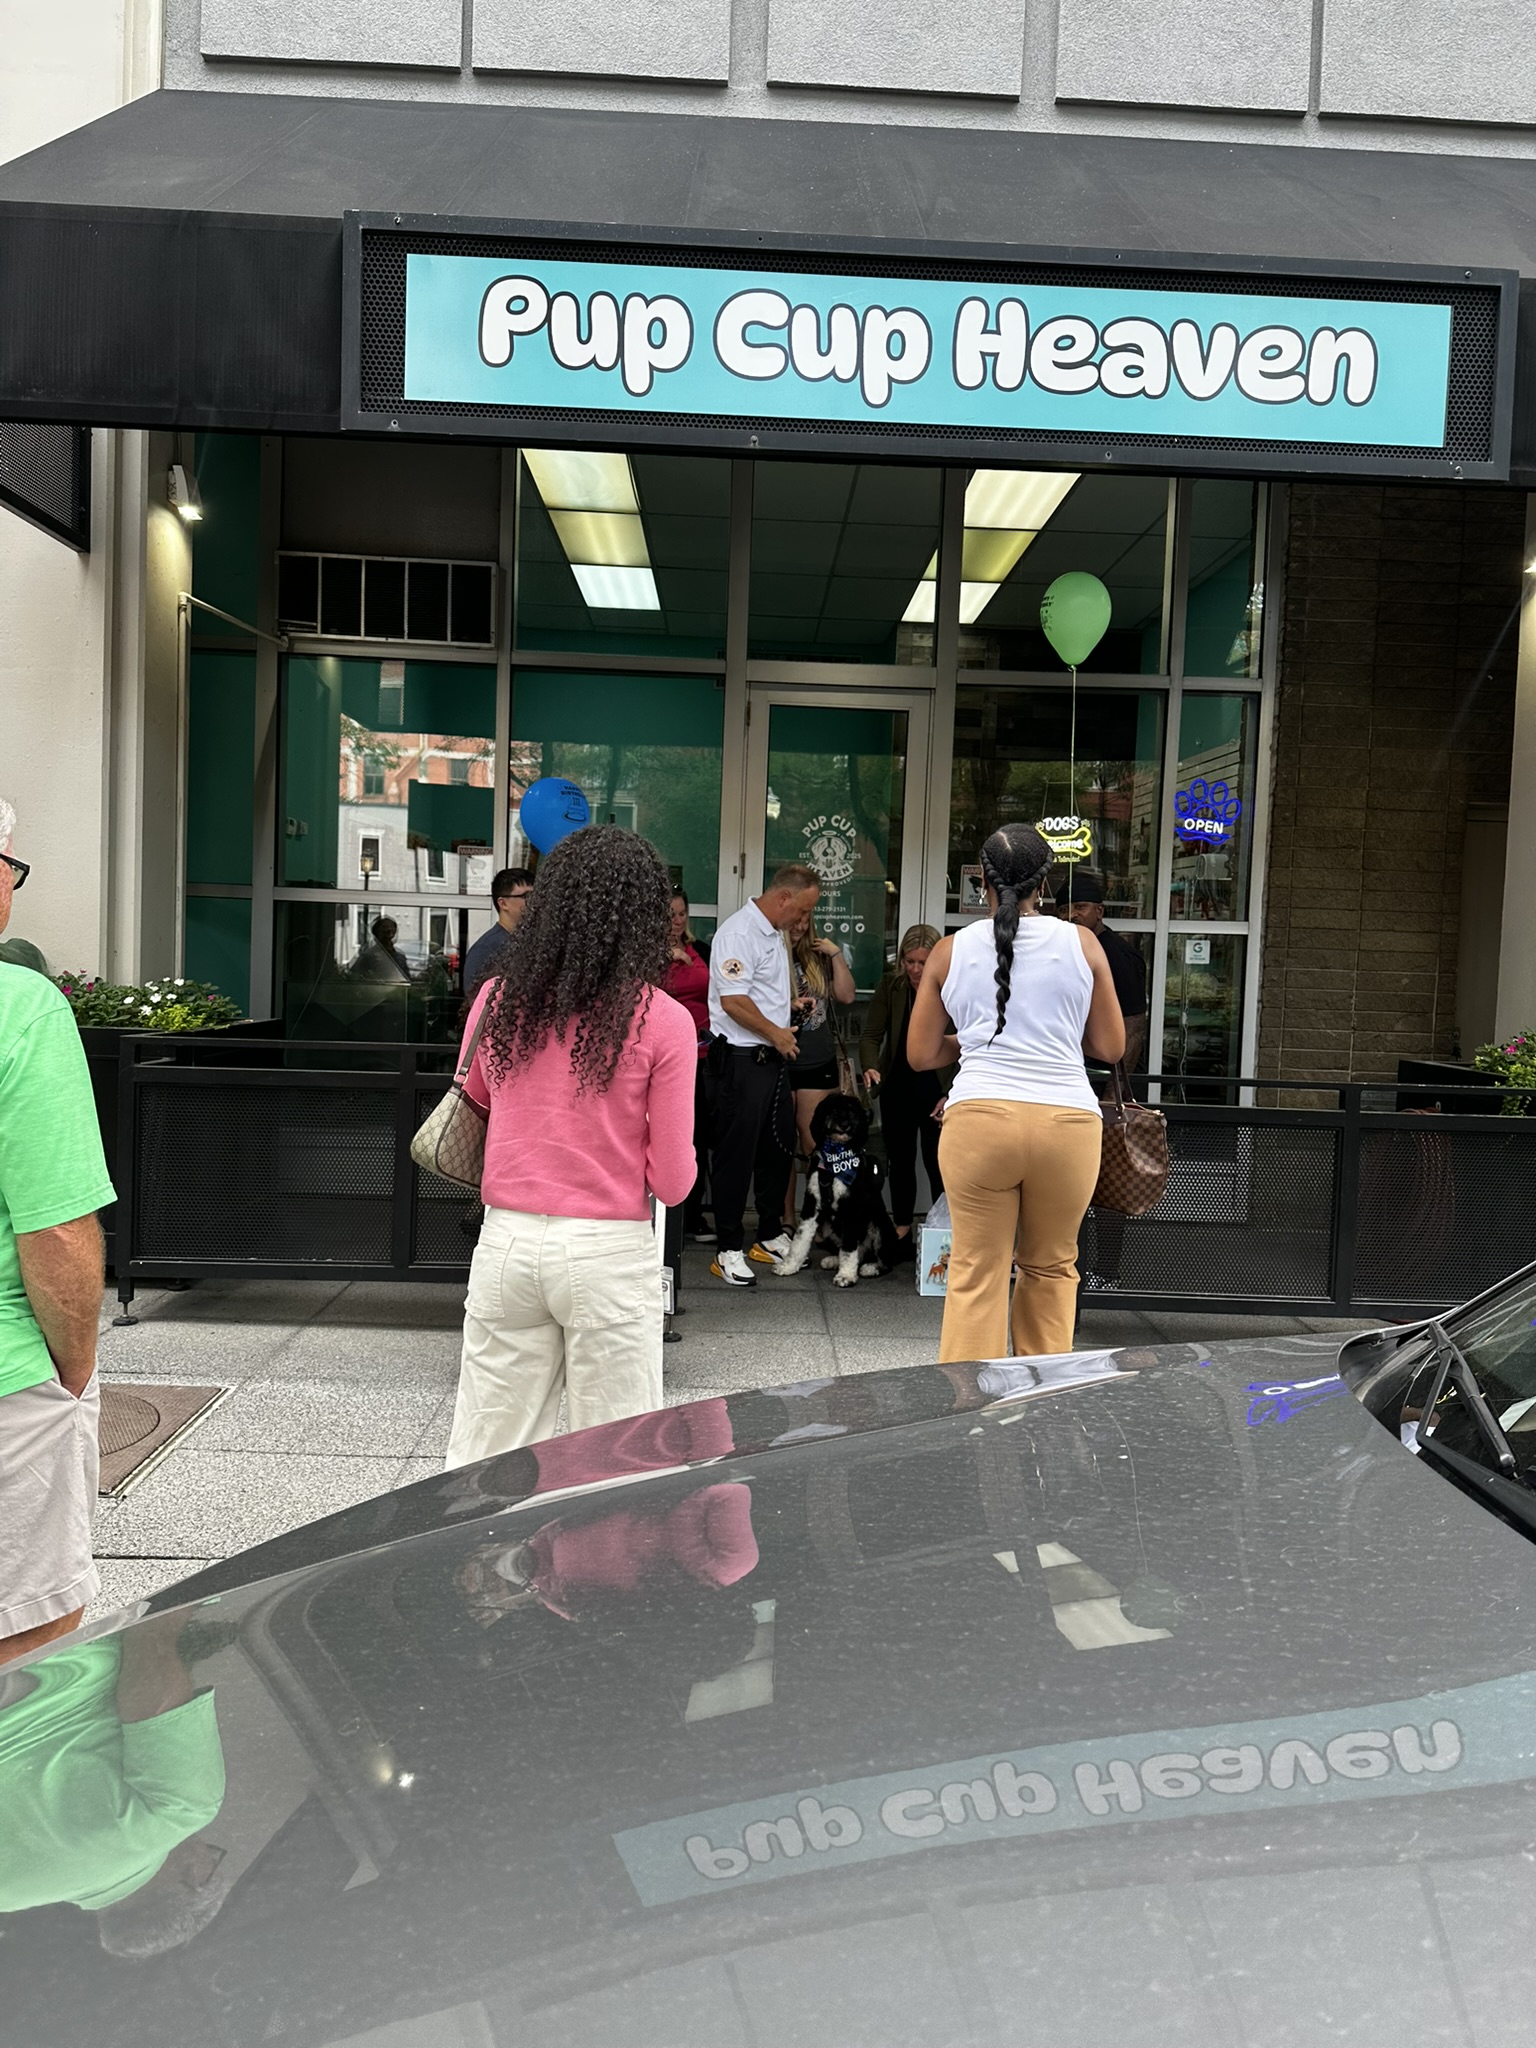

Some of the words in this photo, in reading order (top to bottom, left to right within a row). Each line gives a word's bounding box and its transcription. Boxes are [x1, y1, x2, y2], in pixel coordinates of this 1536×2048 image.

[478, 274, 694, 397] Pup
[713, 288, 932, 408] Cup
[952, 296, 1378, 407] Heaven
[801, 815, 827, 838] PUP
[830, 814, 857, 838] CUP
[1043, 816, 1080, 831] DOGS
[1184, 818, 1224, 834] OPEN
[833, 1158, 852, 1174] BOY
